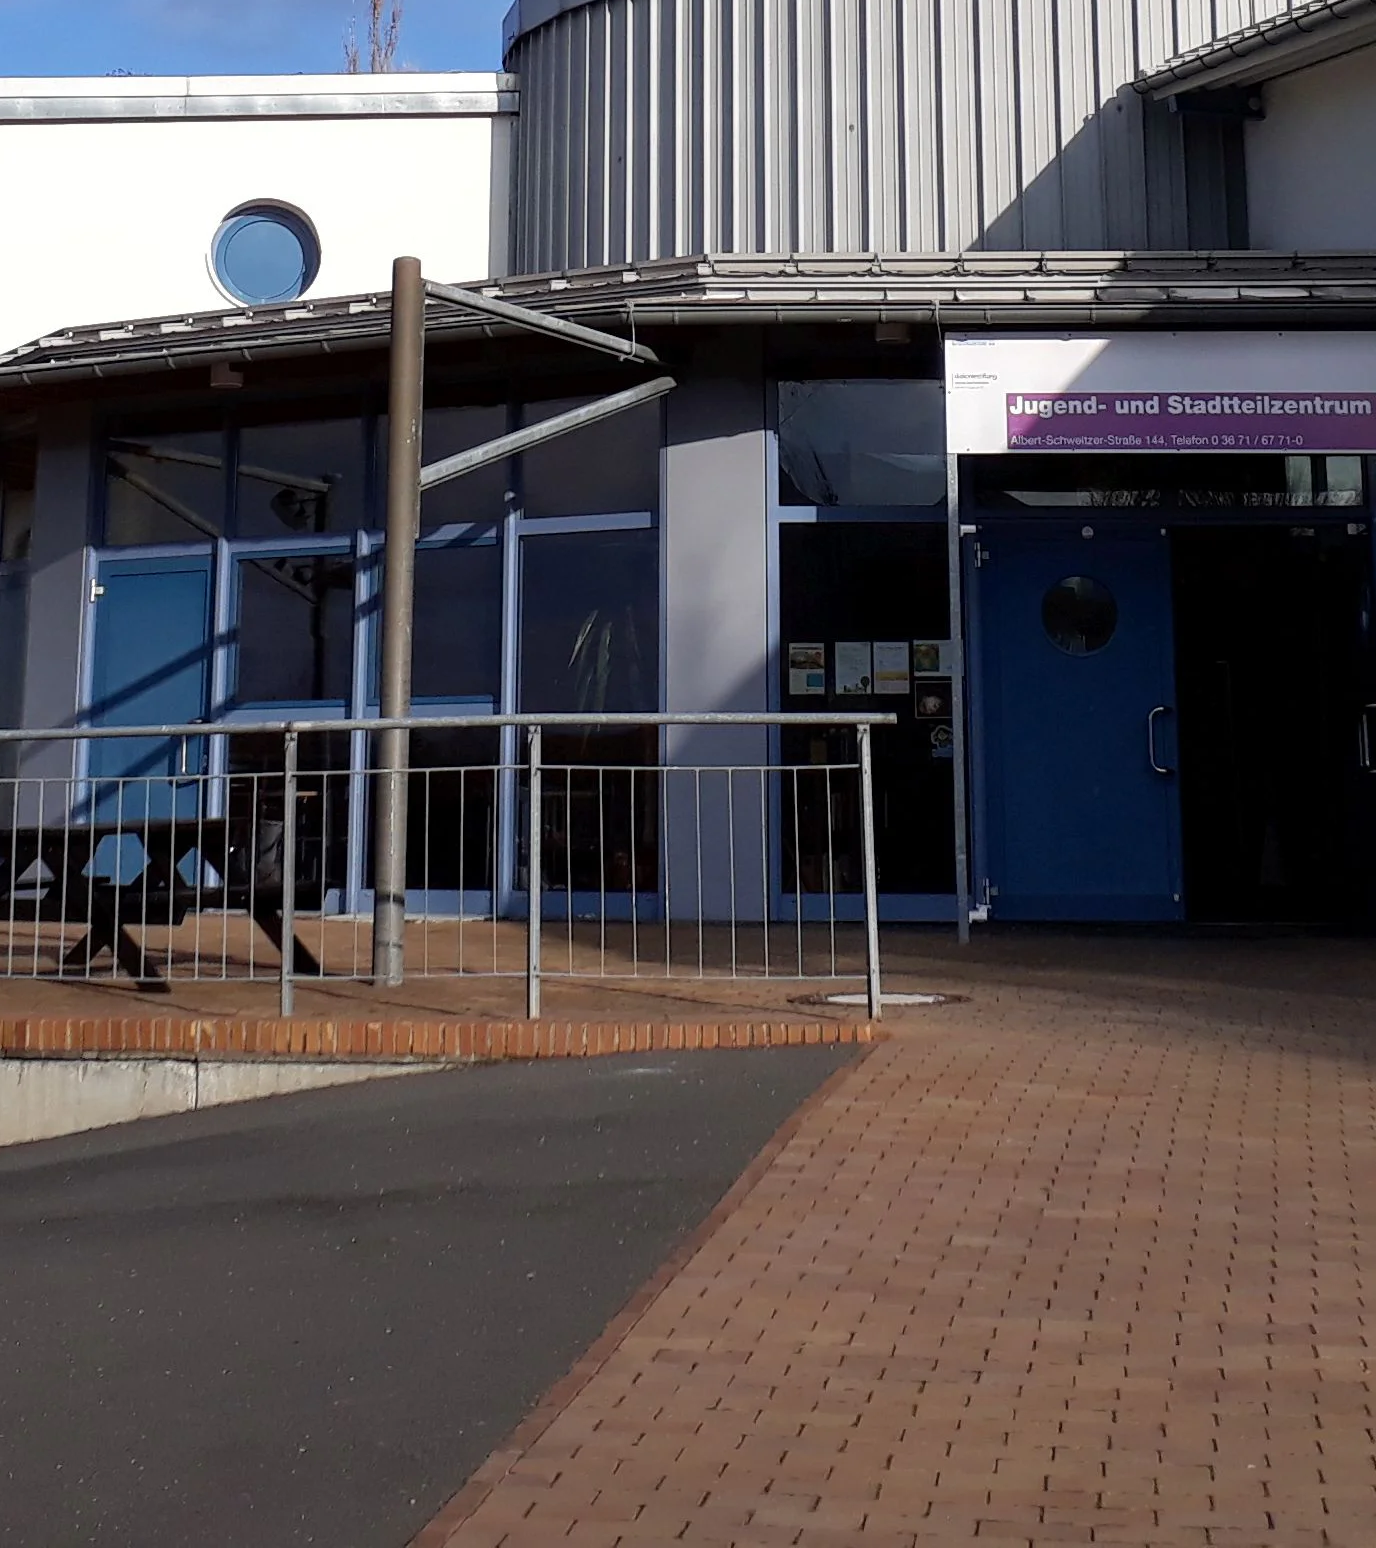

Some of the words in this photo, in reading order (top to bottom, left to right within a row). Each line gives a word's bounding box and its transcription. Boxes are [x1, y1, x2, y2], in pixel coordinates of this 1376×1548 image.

[1010, 396, 1106, 418] Jugend-
[1115, 396, 1159, 415] und
[1167, 395, 1372, 415] Stadtteilzentrum
[1010, 435, 1142, 446] Albert-Schweitzer-Straße
[1146, 435, 1168, 447] 144,
[1172, 434, 1209, 446] Telefon
[1238, 435, 1251, 446] 71
[1261, 435, 1275, 446] 67
